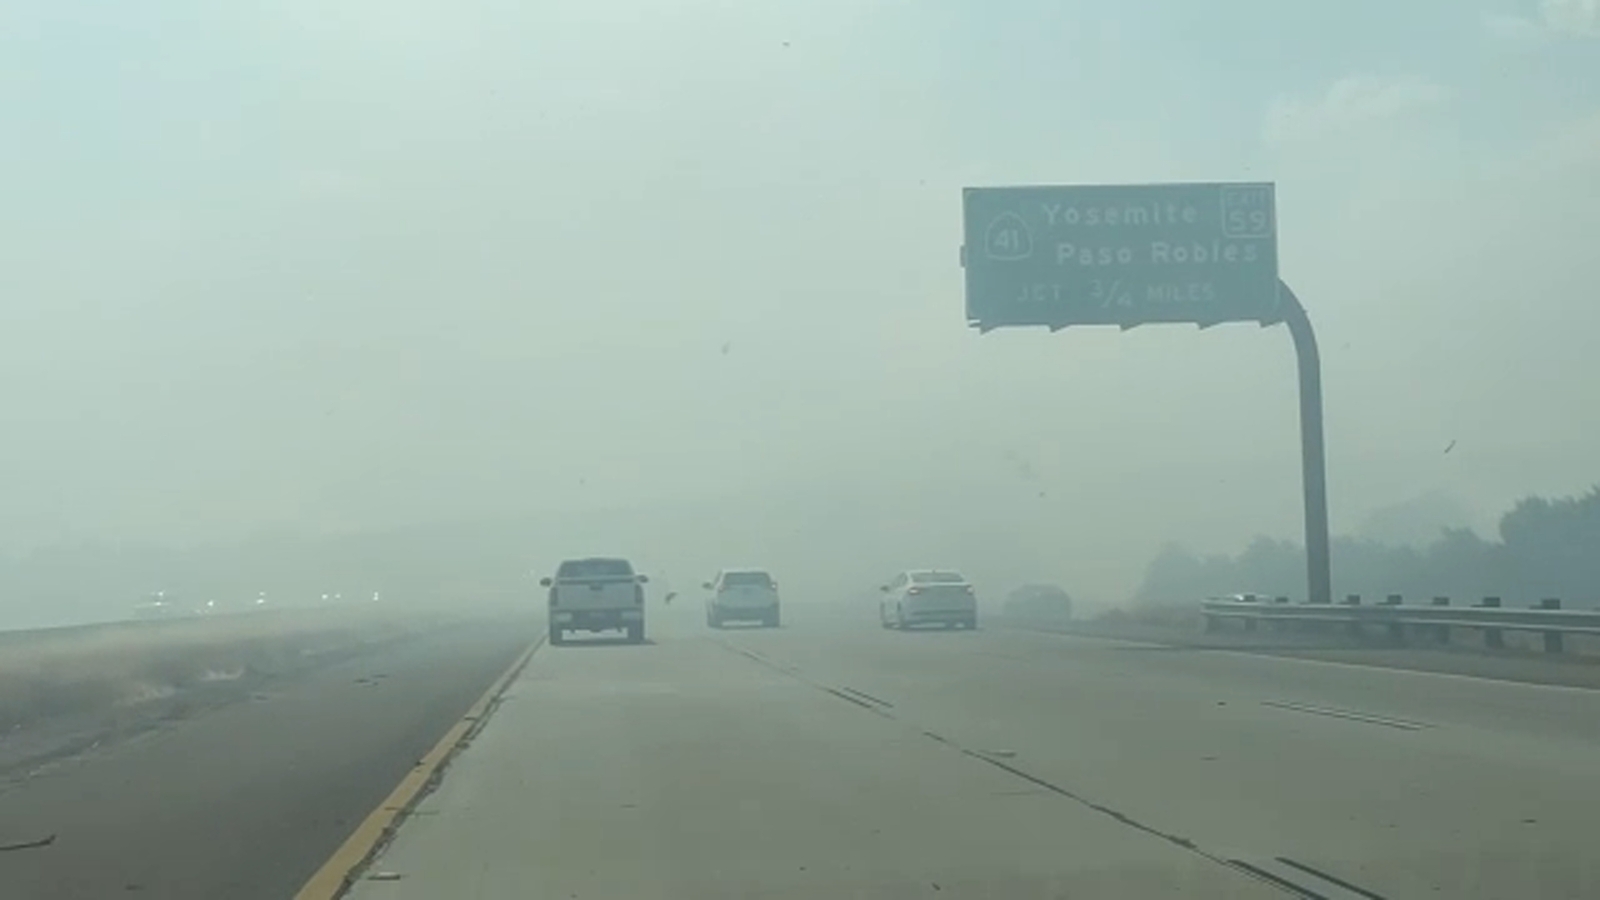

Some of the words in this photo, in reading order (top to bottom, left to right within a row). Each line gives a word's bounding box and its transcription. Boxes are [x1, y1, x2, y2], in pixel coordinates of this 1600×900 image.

[1041, 202, 1197, 226] Yosemite
[1228, 209, 1267, 232] 59
[995, 229, 1019, 250] 41
[1056, 243, 1132, 265] Paso
[1151, 239, 1258, 263] Robles
[1017, 283, 1061, 302] JCT
[1147, 281, 1216, 302] MILES
